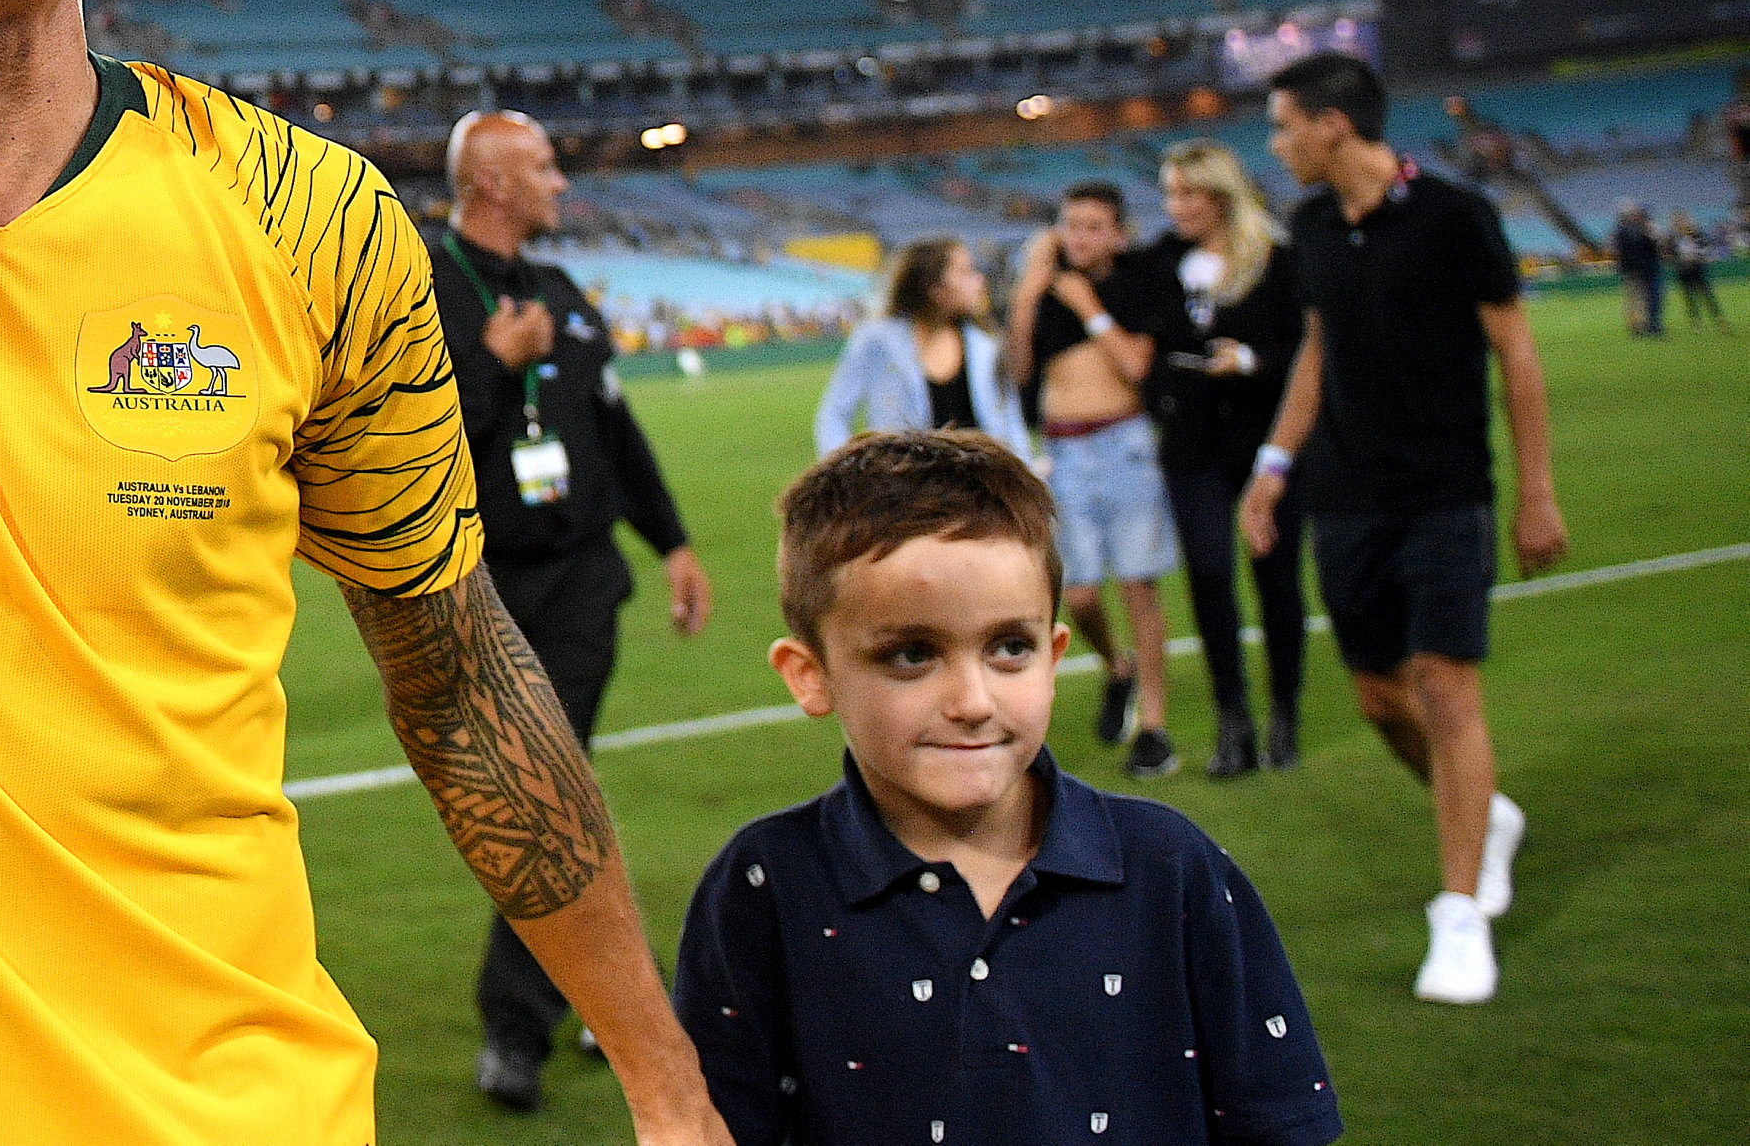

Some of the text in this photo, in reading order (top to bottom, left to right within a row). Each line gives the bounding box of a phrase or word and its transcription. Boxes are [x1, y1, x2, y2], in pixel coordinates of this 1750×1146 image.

[112, 397, 226, 412] AUSTRALIA
[117, 481, 226, 496] AUSTRALIA Vs LEBANON
[106, 493, 151, 504] TUESDAY
[153, 495, 164, 505] 20
[166, 496, 215, 508] NOVEMBER
[127, 507, 214, 520] SYDNEY, AUSTRALIA
